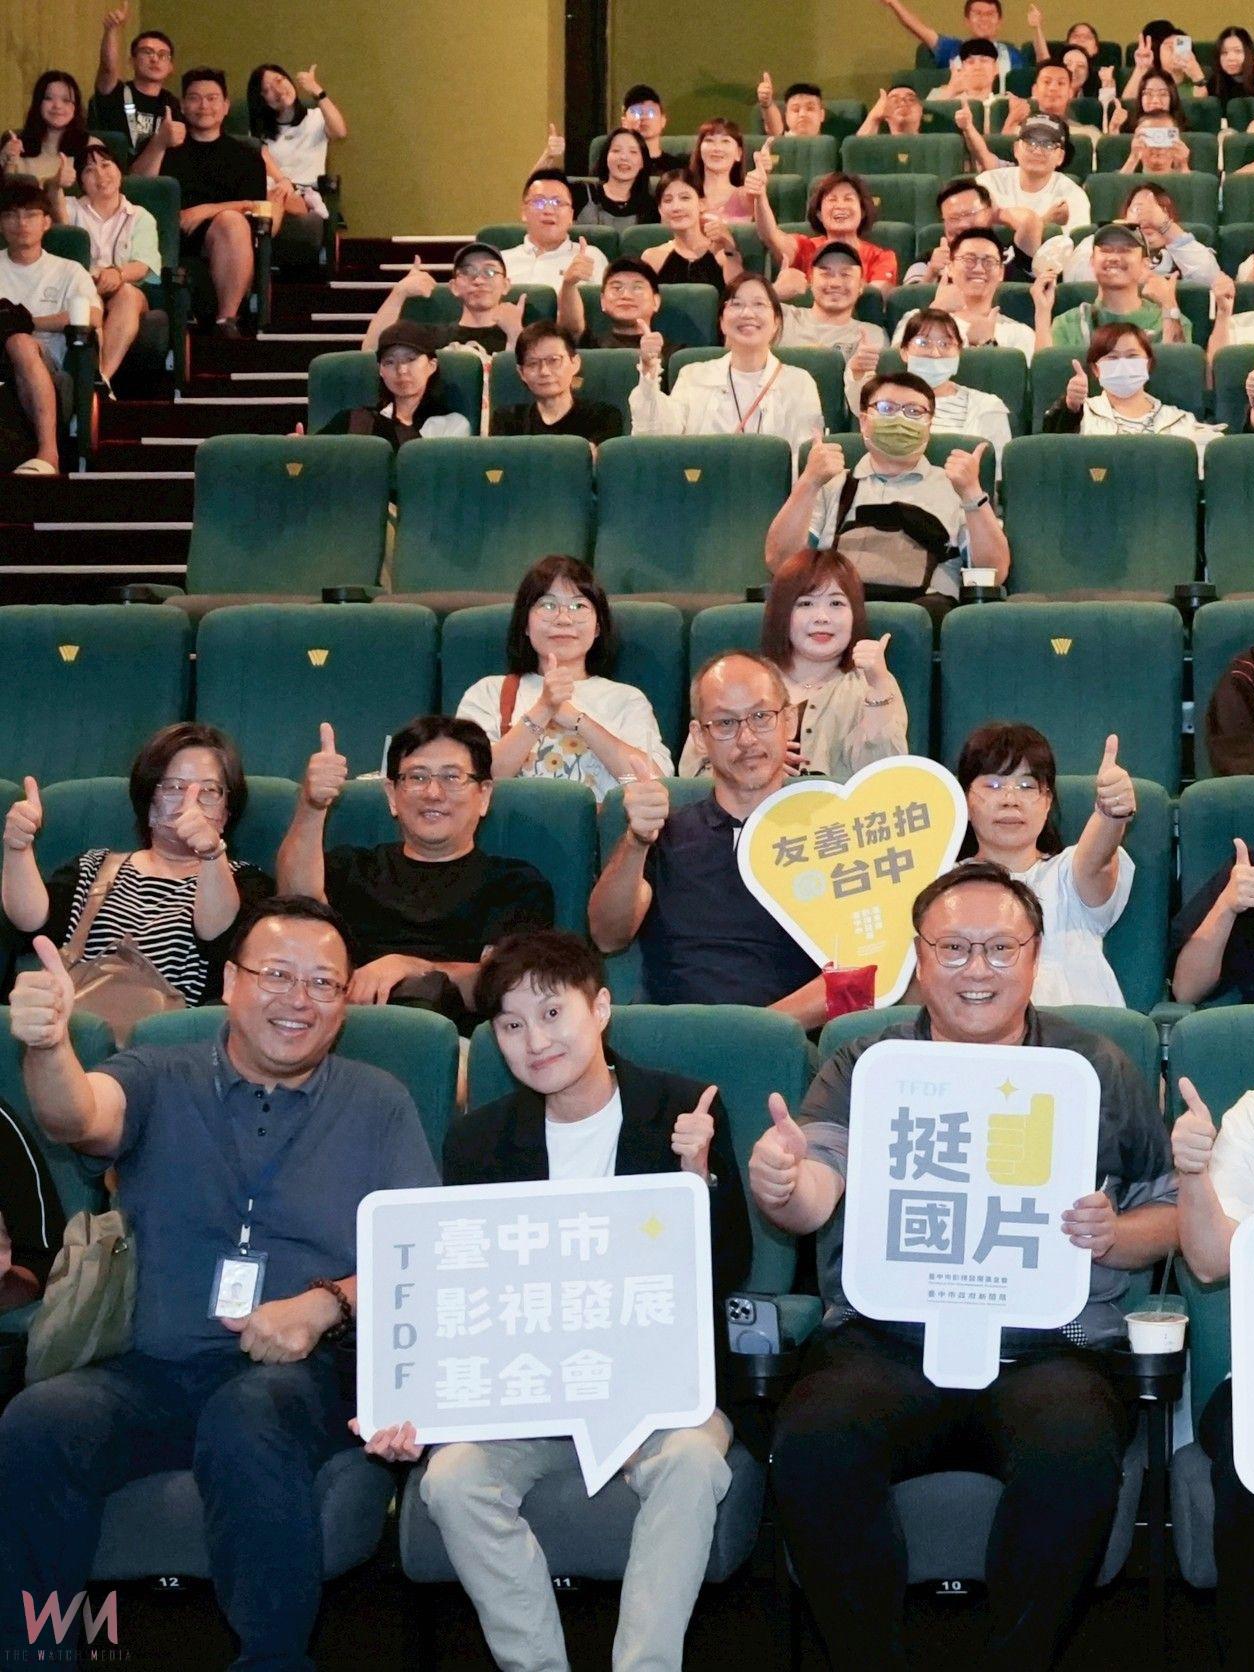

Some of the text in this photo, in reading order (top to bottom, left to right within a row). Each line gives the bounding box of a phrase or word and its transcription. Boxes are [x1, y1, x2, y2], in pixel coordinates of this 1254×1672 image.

[772, 802, 931, 867] 友善協拍
[830, 847, 915, 899] 台中
[888, 1106, 971, 1183] 挺
[434, 1211, 611, 1270] 臺中市
[886, 1189, 1049, 1269] 國片
[434, 1274, 676, 1339] 影視發展
[434, 1348, 614, 1410] 基金會
[159, 1577, 179, 1586] 12
[553, 1578, 571, 1588] 11
[941, 1581, 962, 1591] 10
